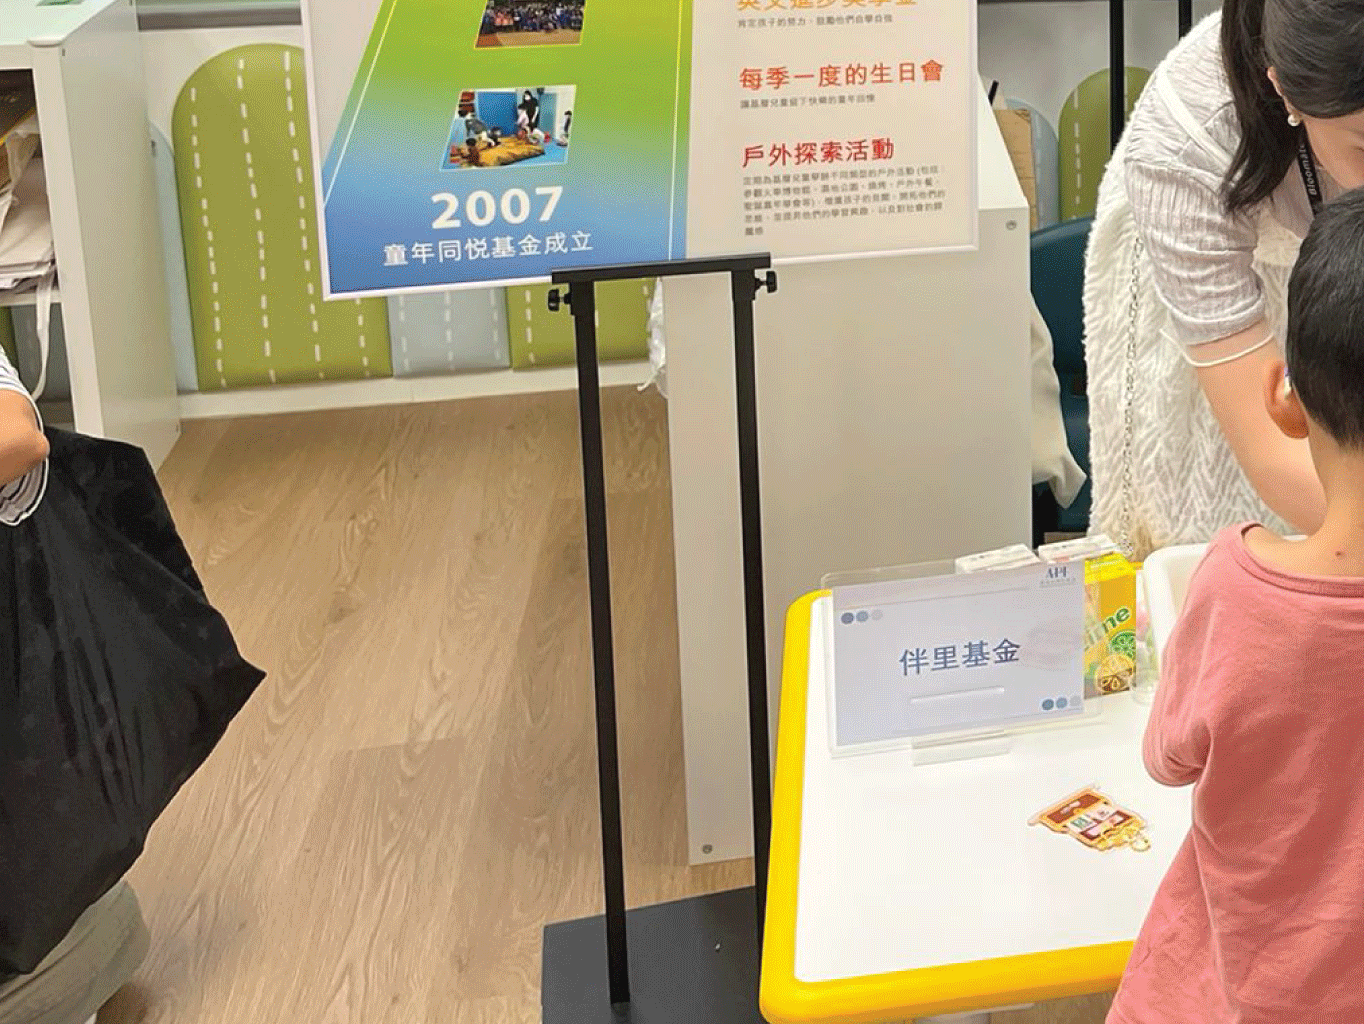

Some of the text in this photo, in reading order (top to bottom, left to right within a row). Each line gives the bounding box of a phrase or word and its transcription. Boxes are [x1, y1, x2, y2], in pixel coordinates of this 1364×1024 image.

[739, 59, 944, 91] 每季一度的生日會
[742, 137, 895, 168] 戶外探索活動
[431, 185, 564, 230] 2007
[898, 637, 1021, 677] 伴里基金
